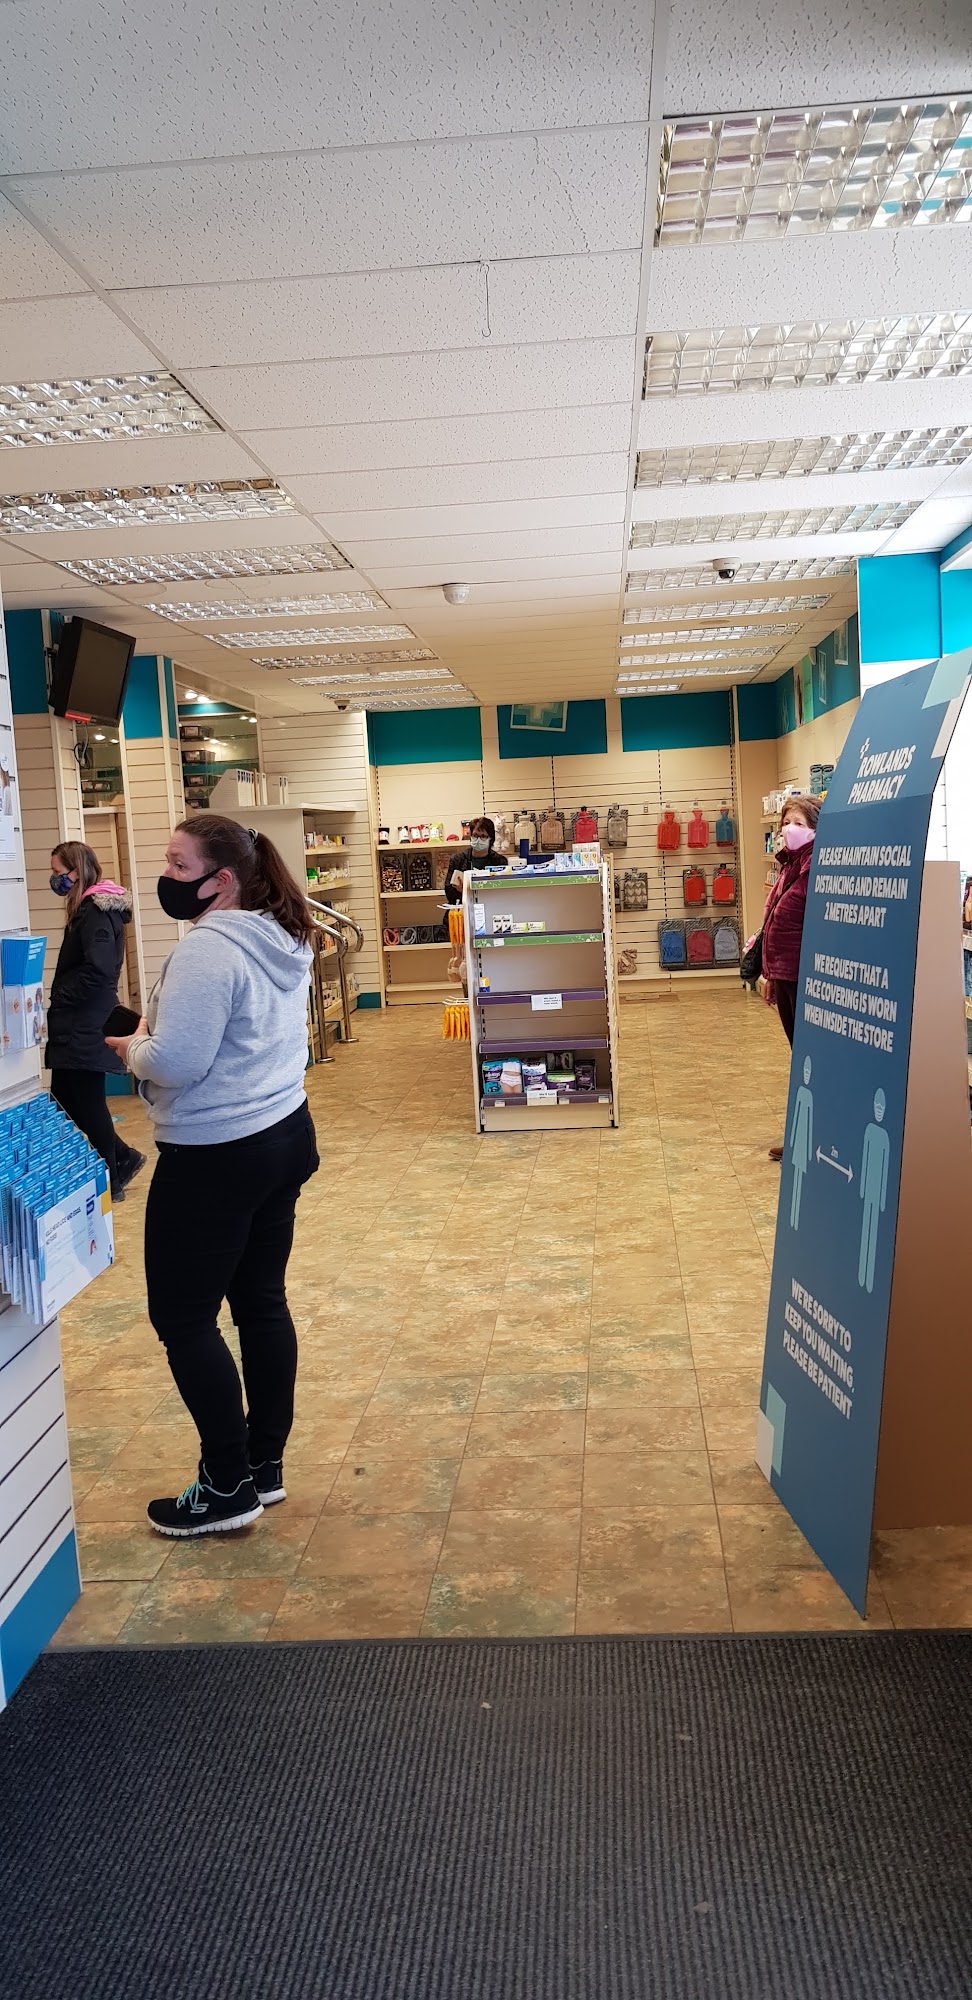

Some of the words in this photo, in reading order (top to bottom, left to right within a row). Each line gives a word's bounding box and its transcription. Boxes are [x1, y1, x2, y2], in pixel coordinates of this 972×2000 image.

[857, 745, 916, 778] ROWLANDS
[847, 774, 906, 804] PHARMACY
[818, 847, 842, 866] PLEASE
[841, 845, 880, 866] MAINTAIN
[879, 845, 911, 866] SOCIAL
[815, 875, 855, 895] DISTANCING
[854, 877, 872, 897] AND
[872, 877, 908, 899] REMAIN
[824, 901, 829, 920] 2
[829, 902, 858, 924] METRES
[857, 905, 887, 928] APART
[815, 953, 825, 973] WE
[825, 955, 859, 982] REQUEST
[859, 963, 882, 987] THAT
[881, 968, 888, 989] A
[805, 977, 821, 998] FACE
[821, 981, 859, 1011] COVERING
[859, 992, 867, 1014] IS
[868, 994, 897, 1022] WORN
[804, 1003, 824, 1028] WHEN
[823, 1009, 847, 1036] INSIDE
[847, 1018, 864, 1042] THE
[864, 1023, 894, 1053] STORE
[785, 1301, 801, 1333] KEEP
[801, 1319, 818, 1351] YOU
[812, 1299, 840, 1340] SORRY
[839, 1323, 851, 1353] TO
[783, 1329, 809, 1373] PLEASE
[808, 1355, 818, 1384] BE
[818, 1366, 852, 1420] PATIENT
